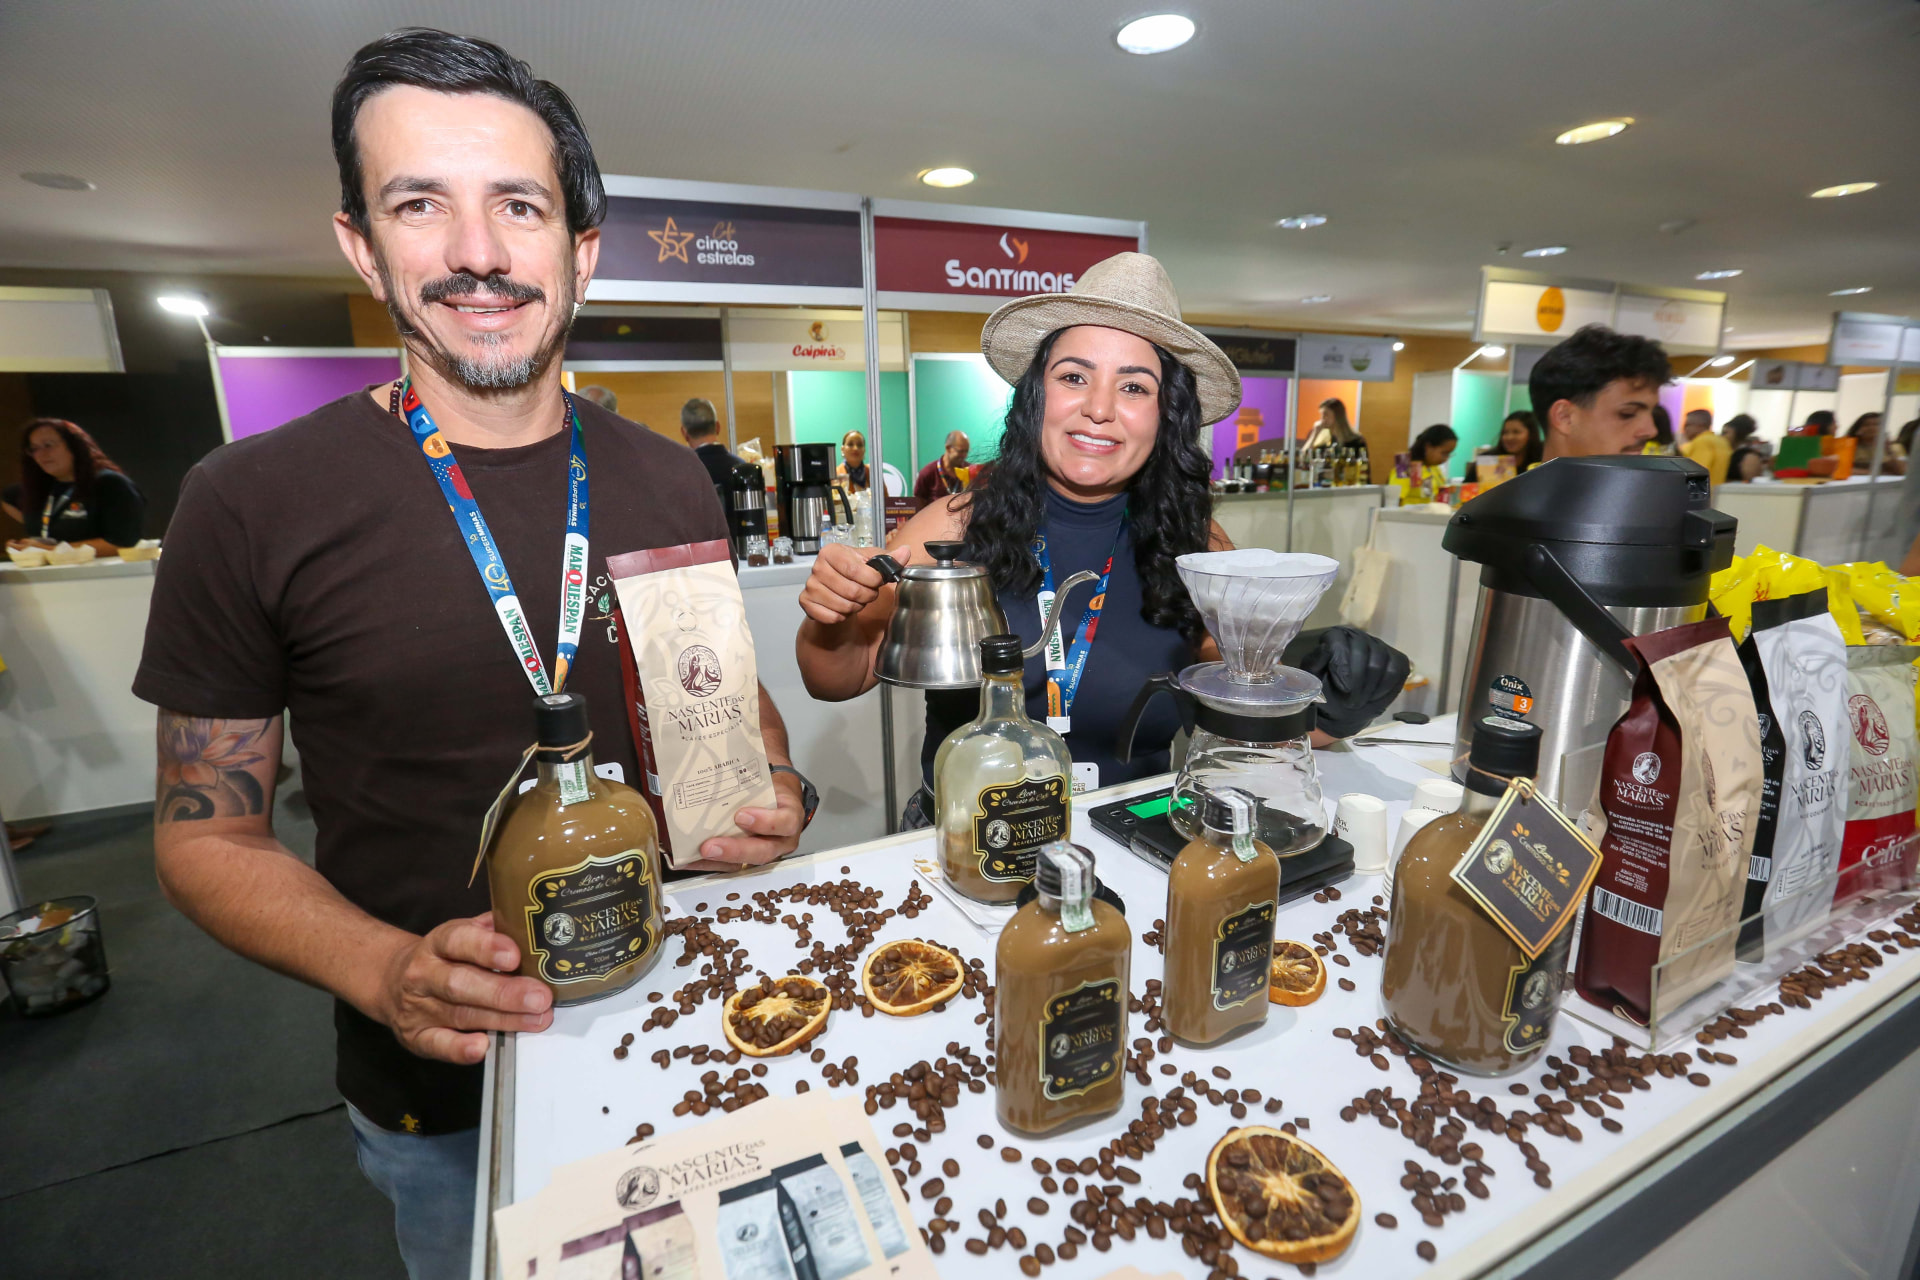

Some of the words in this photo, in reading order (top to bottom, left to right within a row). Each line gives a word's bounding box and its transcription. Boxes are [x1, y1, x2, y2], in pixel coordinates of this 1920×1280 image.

[696, 235, 738, 251] cinco
[696, 251, 755, 267] estrelas
[565, 544, 583, 634] MARQUESPAN
[669, 696, 731, 721] NASCENTE
[731, 695, 745, 704] DAS
[1520, 698, 1527, 708] 3
[679, 705, 741, 734] MARIAS
[1850, 757, 1900, 780] NASCENTE
[1613, 779, 1658, 797] NASCENTE
[1859, 769, 1910, 796] MARIAS
[1616, 787, 1664, 806] MARIAS
[1010, 816, 1052, 831] NASCENTE
[1609, 811, 1636, 822] Fazenda
[1015, 823, 1058, 841] MARIAS
[1508, 870, 1552, 917] MARIAS
[573, 901, 629, 923] NASCENTE
[582, 907, 639, 935] MARIAS
[659, 1142, 745, 1176] NASCENTE
[745, 1140, 766, 1152] DAS
[671, 1151, 760, 1191] MARIAS
